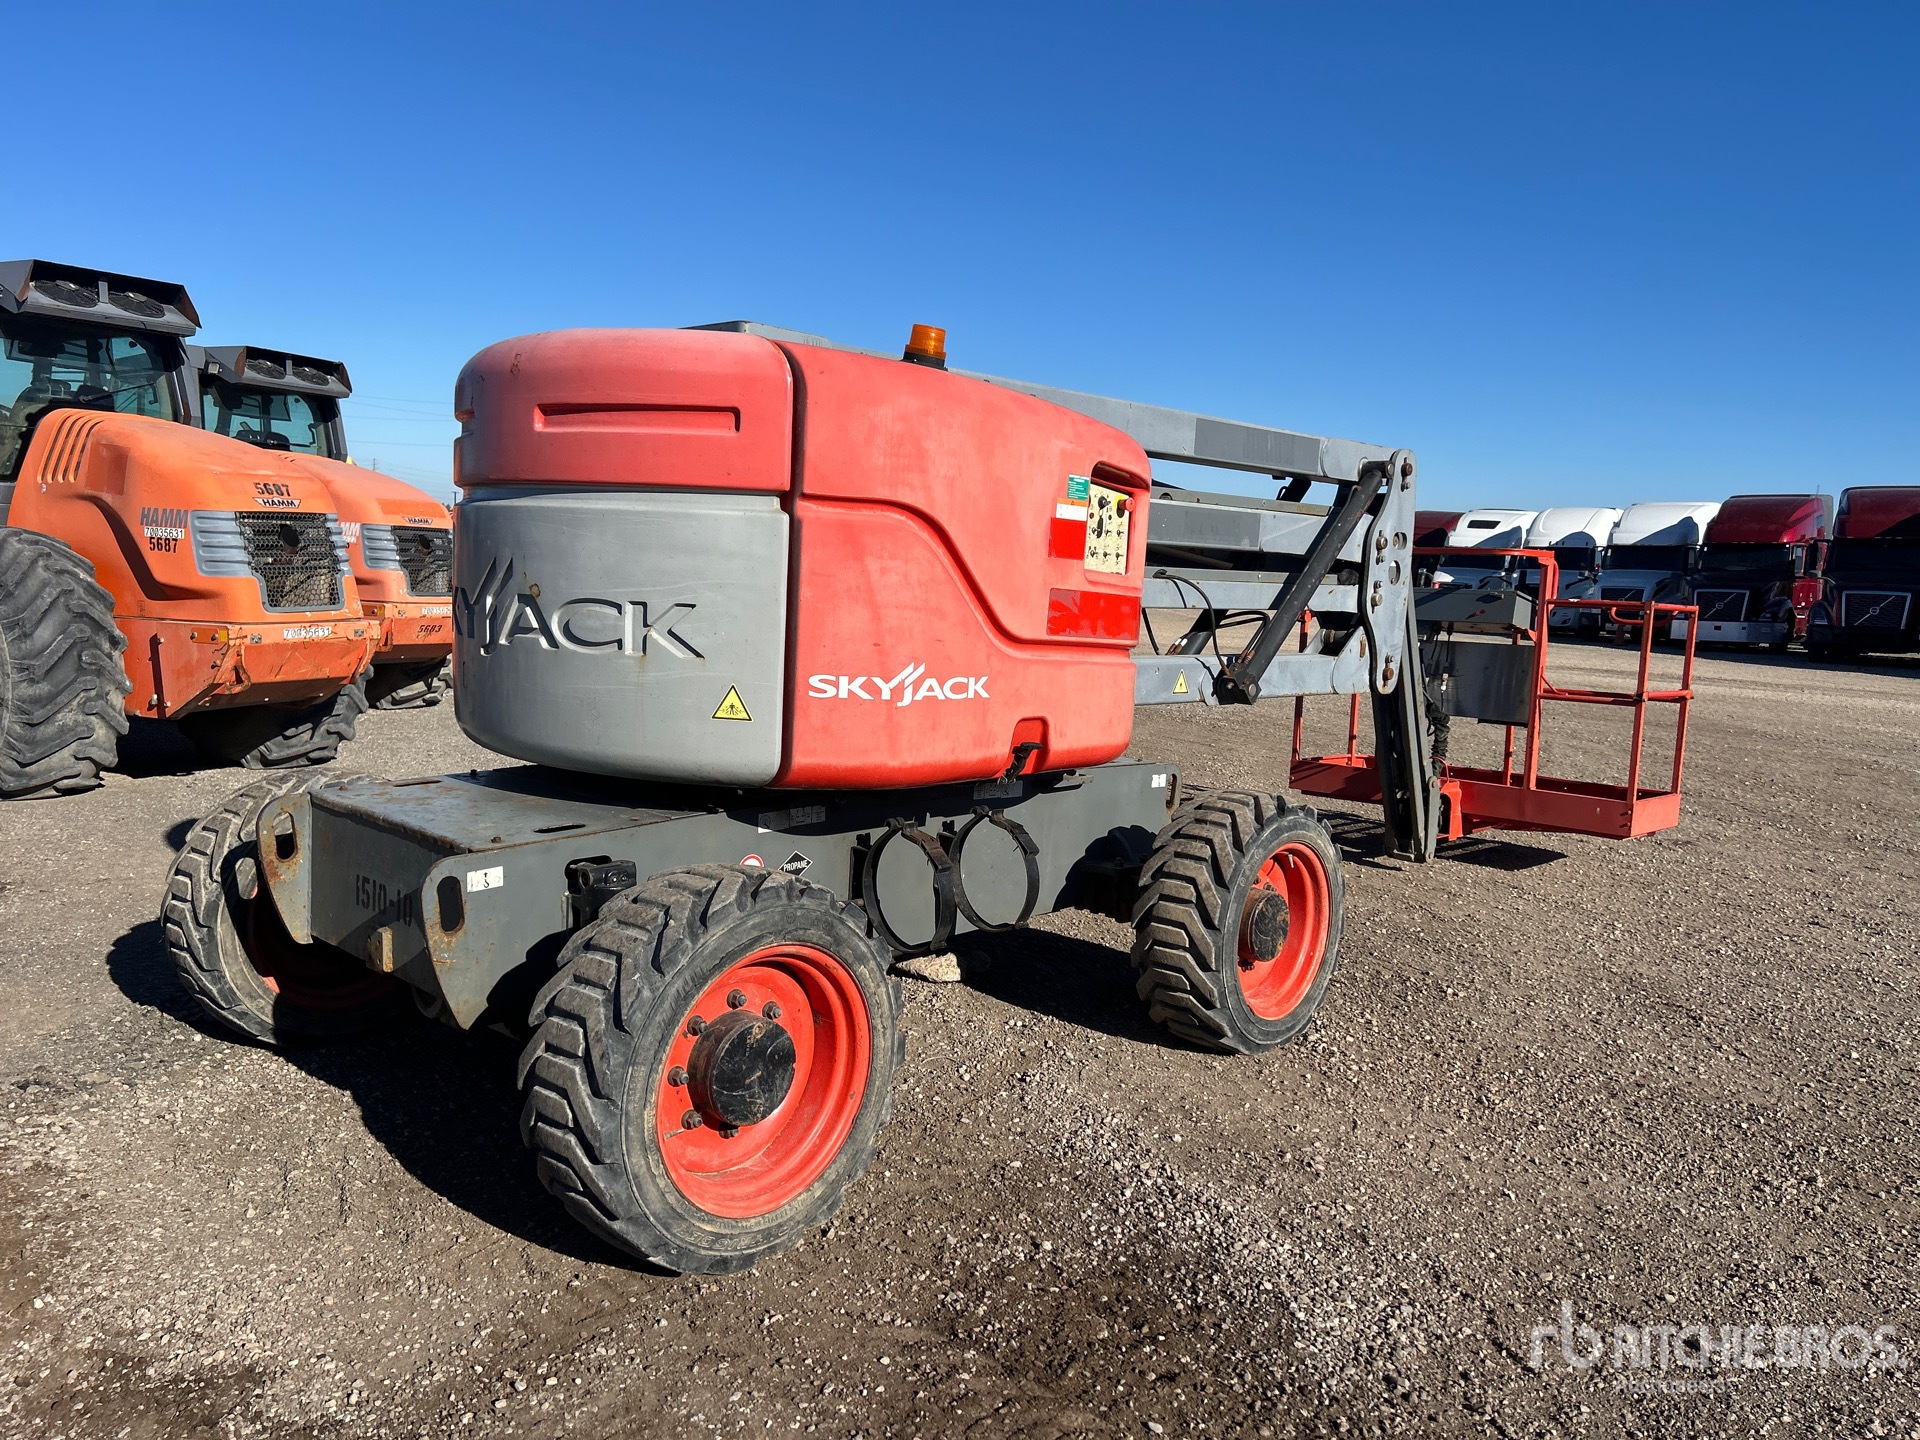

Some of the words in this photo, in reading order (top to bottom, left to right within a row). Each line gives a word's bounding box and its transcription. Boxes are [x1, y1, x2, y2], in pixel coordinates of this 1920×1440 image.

[253, 482, 291, 497] 5687
[262, 499, 296, 508] HAMM
[140, 507, 189, 528] HAMM
[145, 527, 184, 539] 70035631
[149, 537, 179, 553] 5687
[807, 661, 991, 707] SKYJACK
[783, 860, 808, 872] PROPANE
